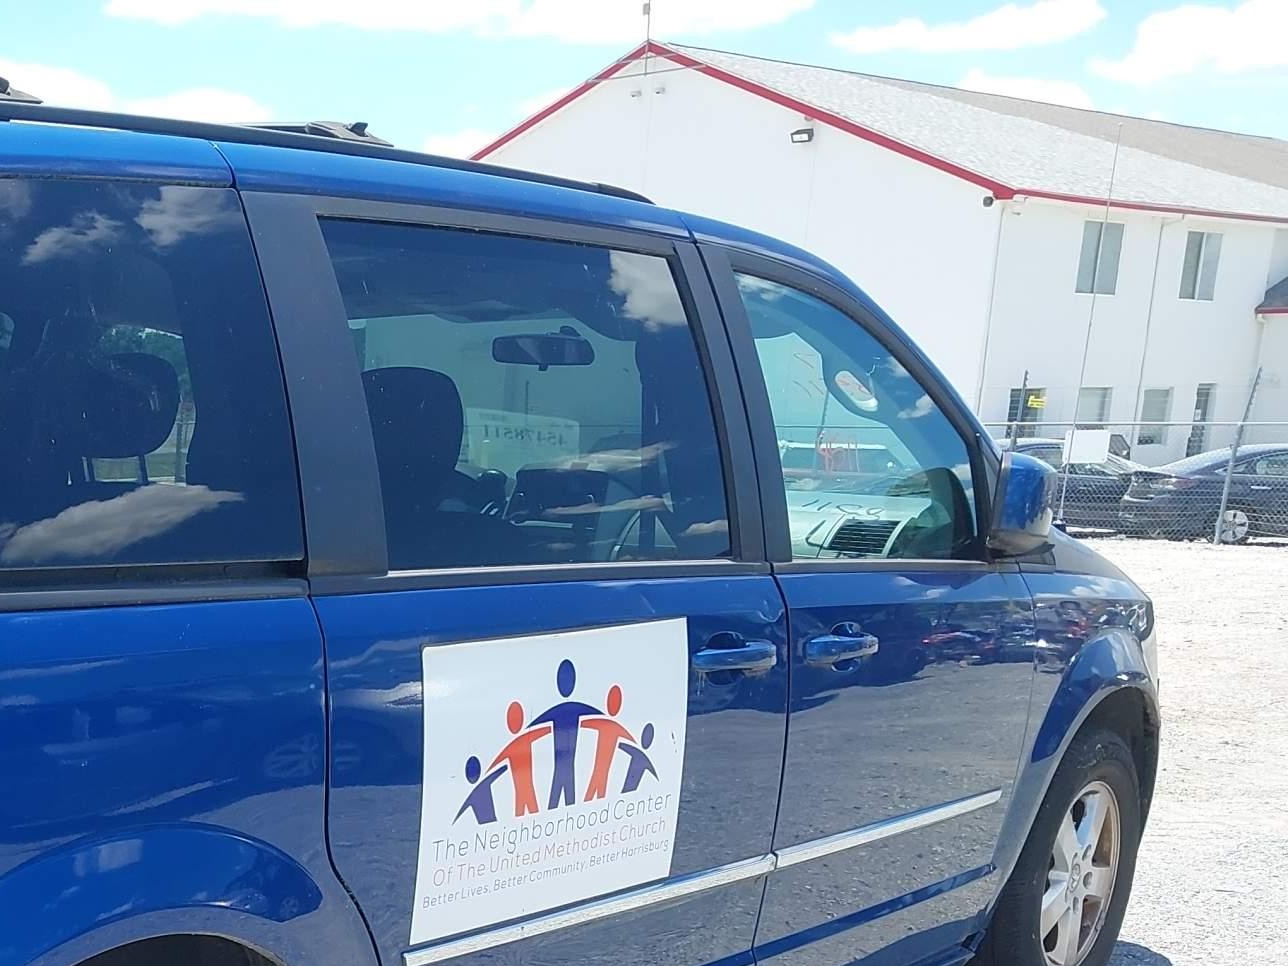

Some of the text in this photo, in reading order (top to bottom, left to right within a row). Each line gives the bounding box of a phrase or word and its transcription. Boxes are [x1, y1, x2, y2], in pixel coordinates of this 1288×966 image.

[432, 793, 672, 863] The Neighborhood Center
[433, 816, 666, 887] Of The United Methodist Church
[422, 891, 460, 909] Better
[493, 874, 528, 892] Better
[589, 851, 620, 868] Better
[621, 839, 669, 859] Harrisburg
